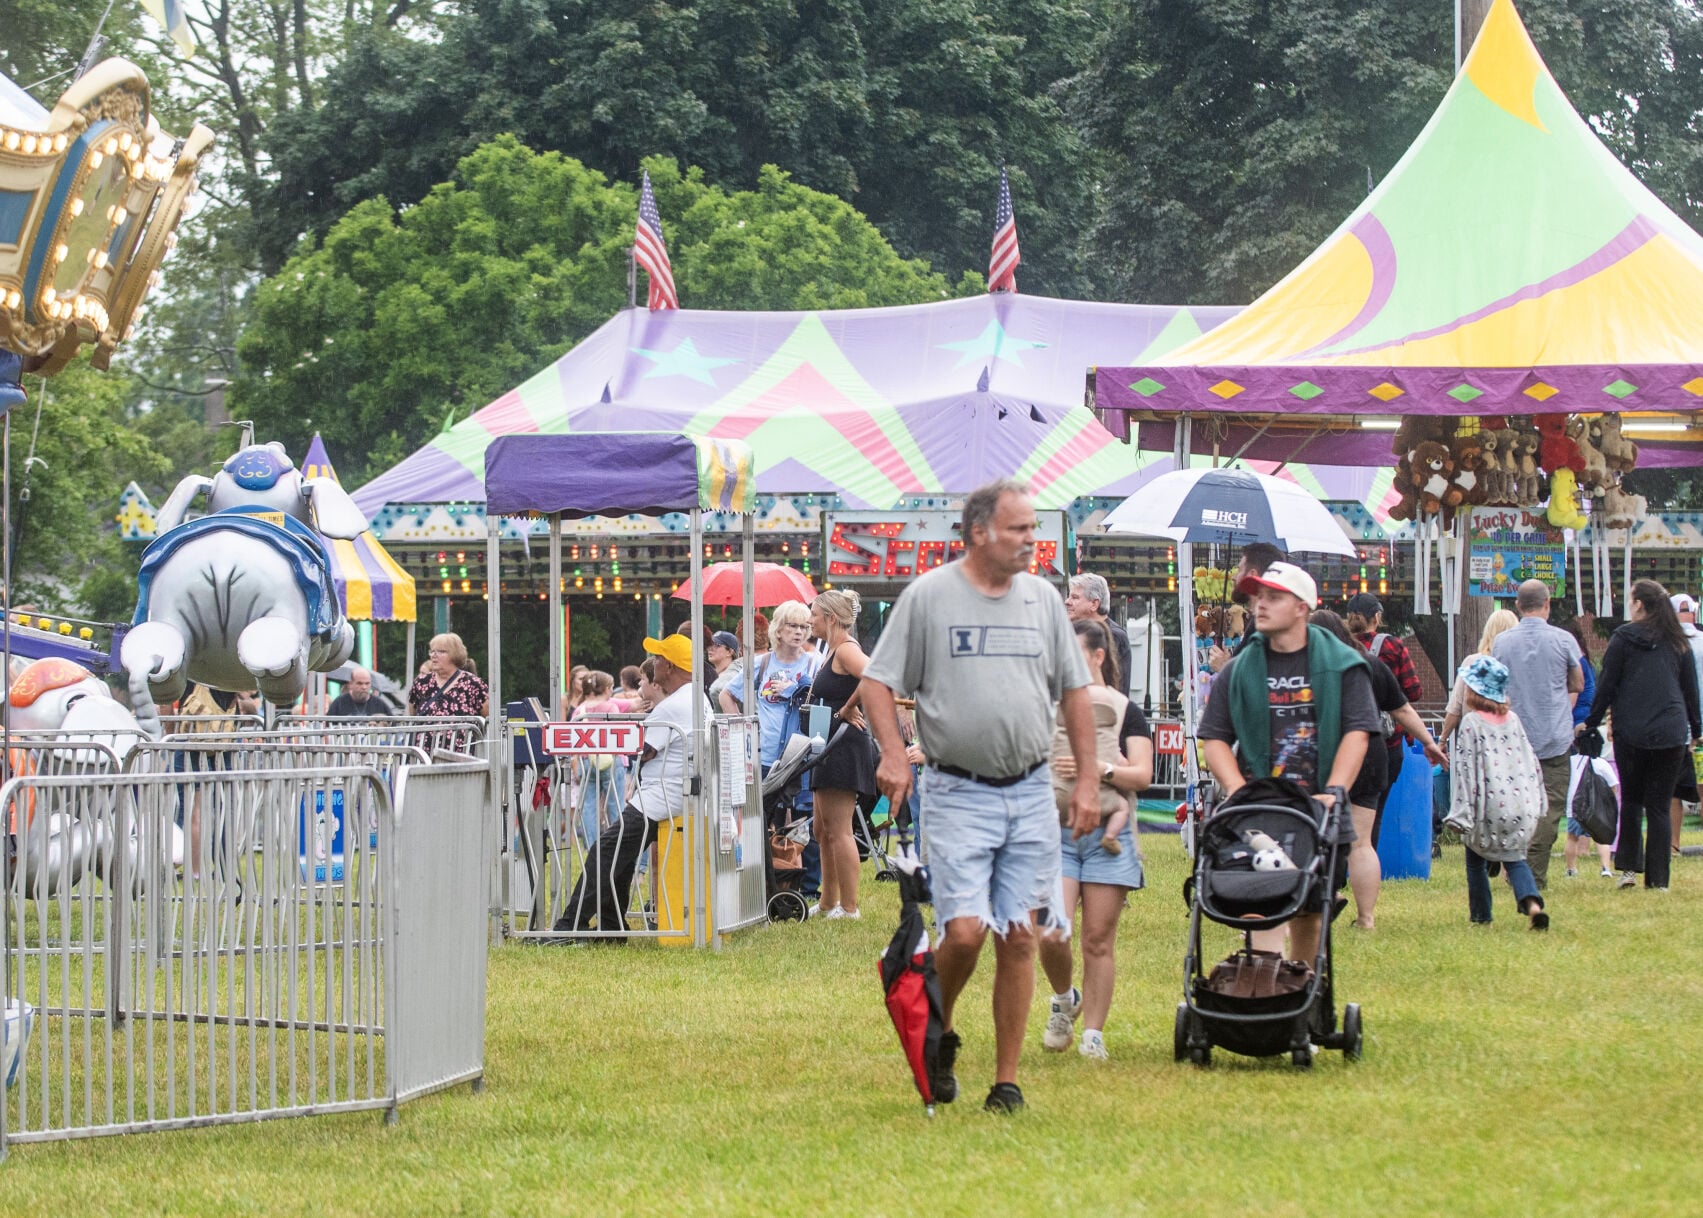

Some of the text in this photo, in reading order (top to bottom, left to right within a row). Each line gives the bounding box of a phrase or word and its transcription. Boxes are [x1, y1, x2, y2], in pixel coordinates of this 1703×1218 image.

[1218, 511, 1248, 523] HCH
[1474, 512, 1517, 532] Lucky
[553, 728, 631, 749] EXIT
